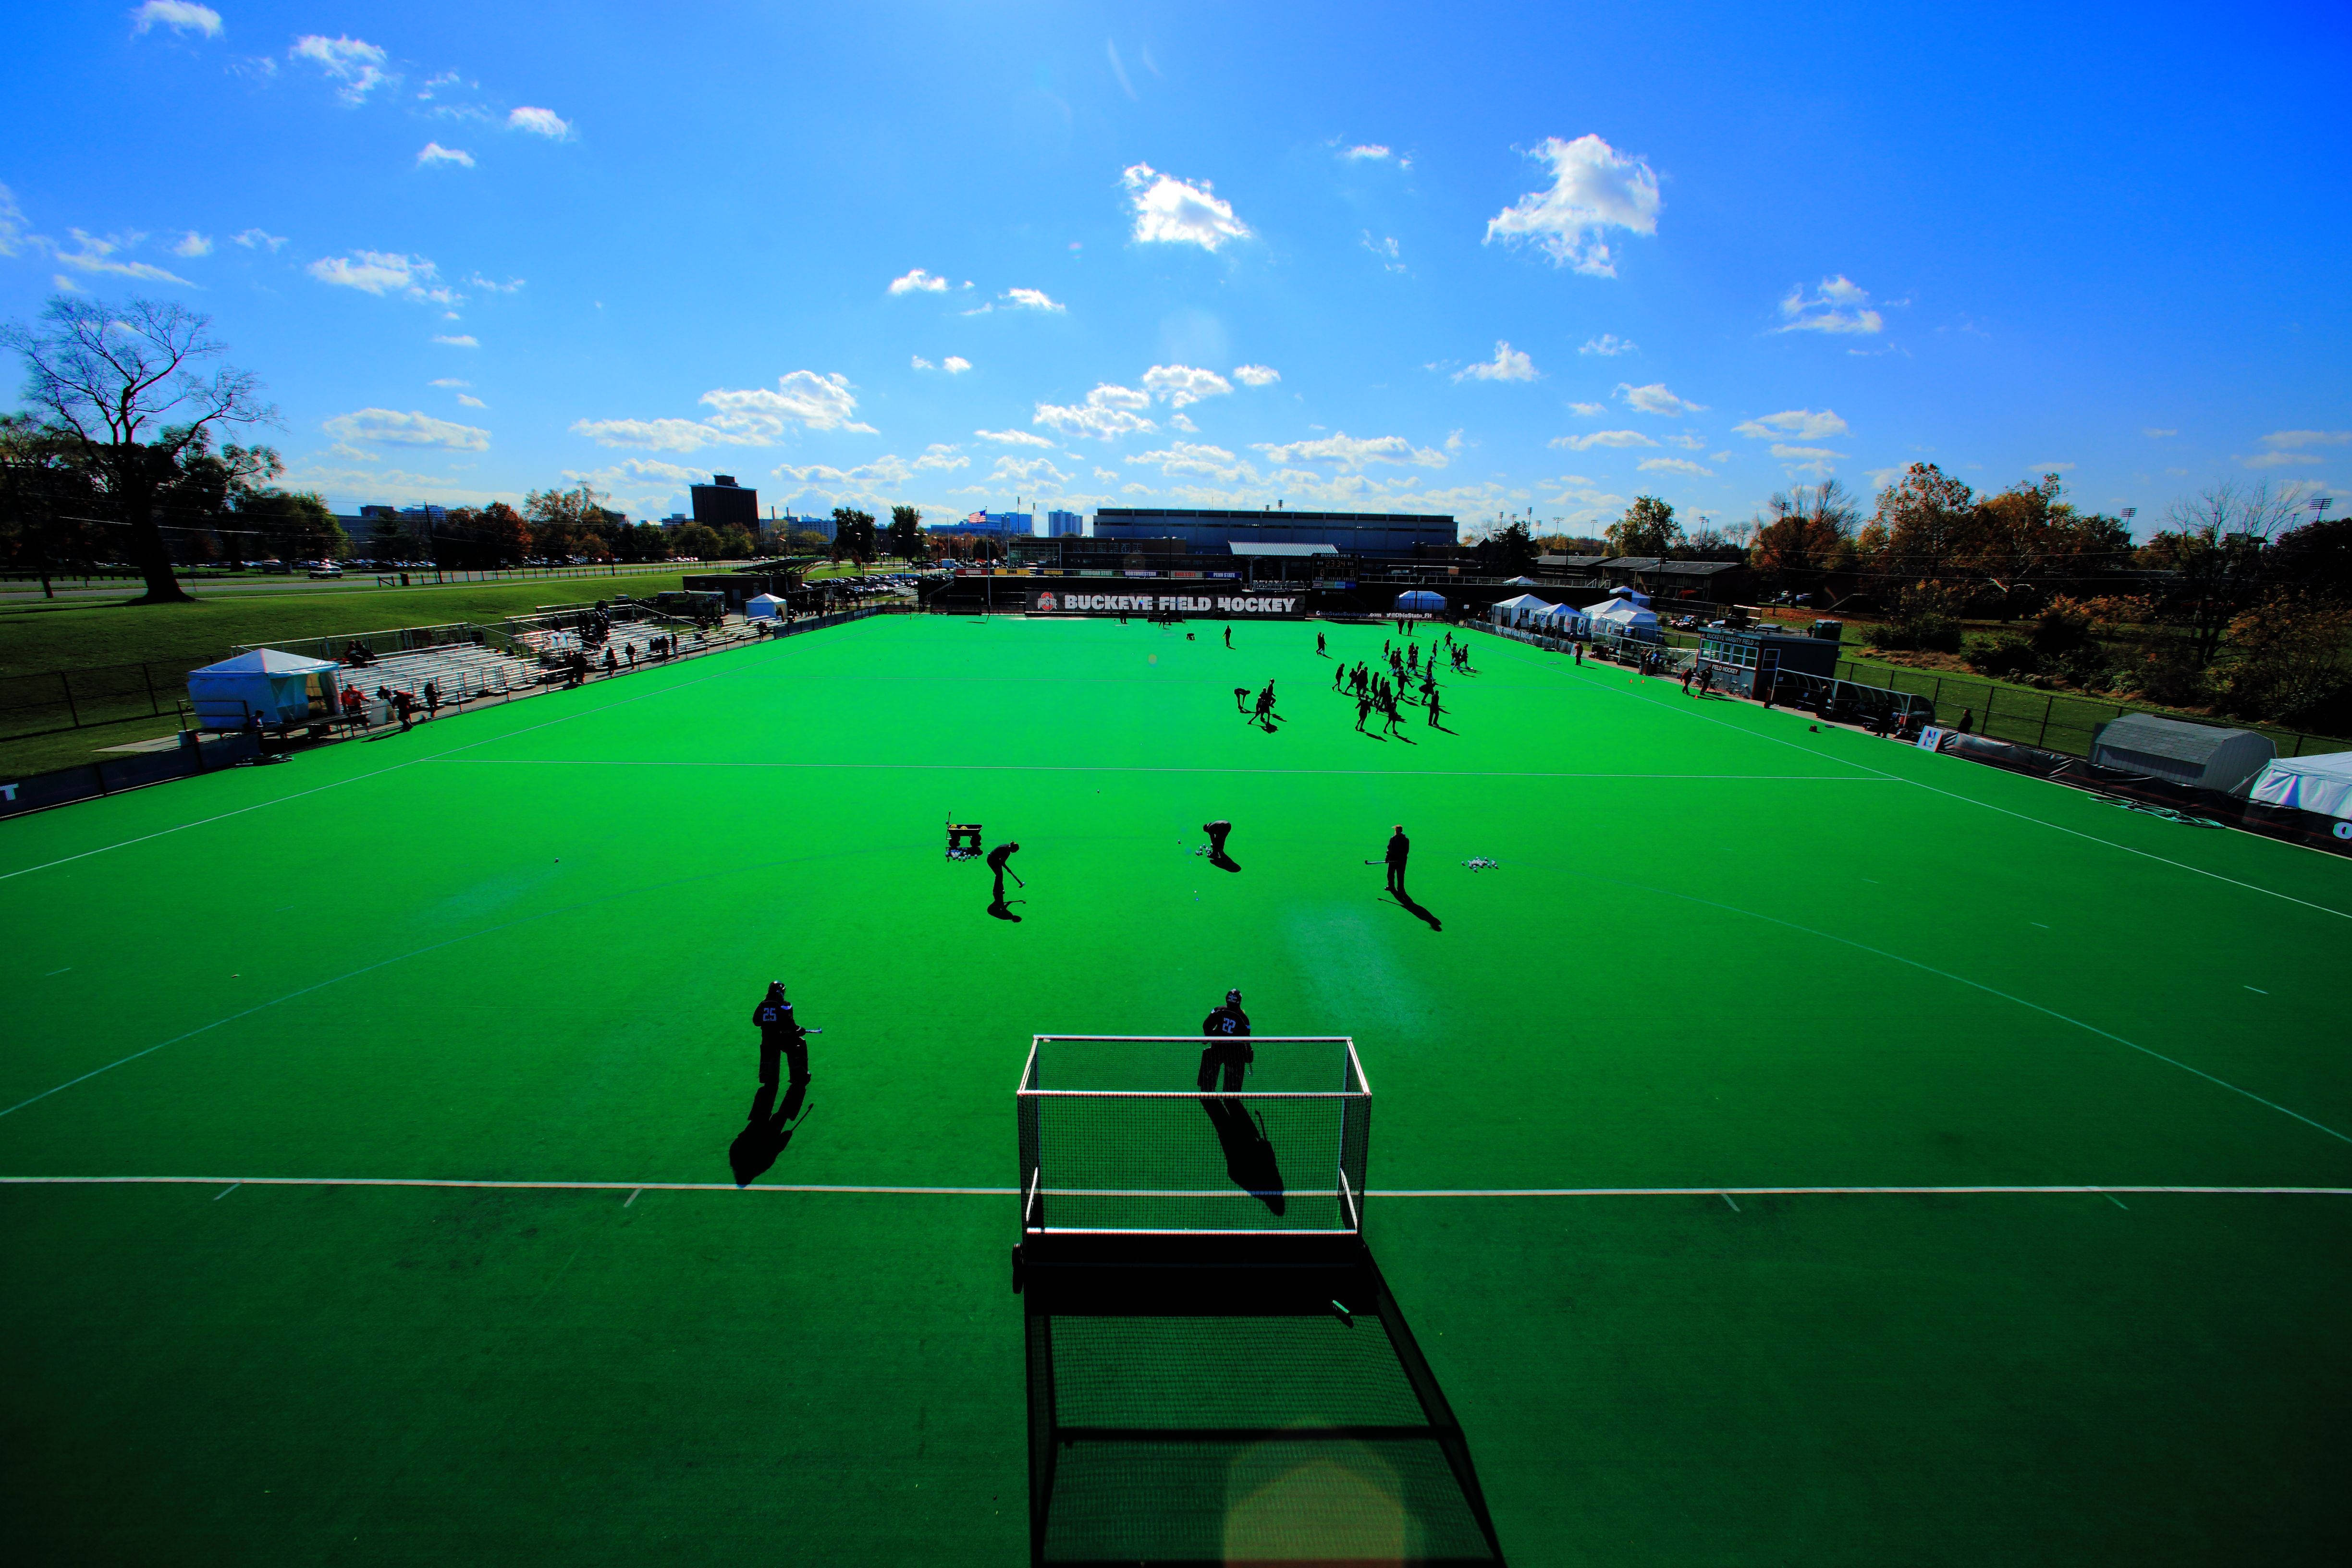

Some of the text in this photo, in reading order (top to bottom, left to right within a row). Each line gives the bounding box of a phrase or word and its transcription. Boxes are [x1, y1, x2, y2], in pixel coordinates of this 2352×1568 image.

[1065, 595, 1296, 612] BUCKEYE FIELD HOCKEY
[763, 1007, 777, 1021] 25
[1222, 1017, 1236, 1034] 22
